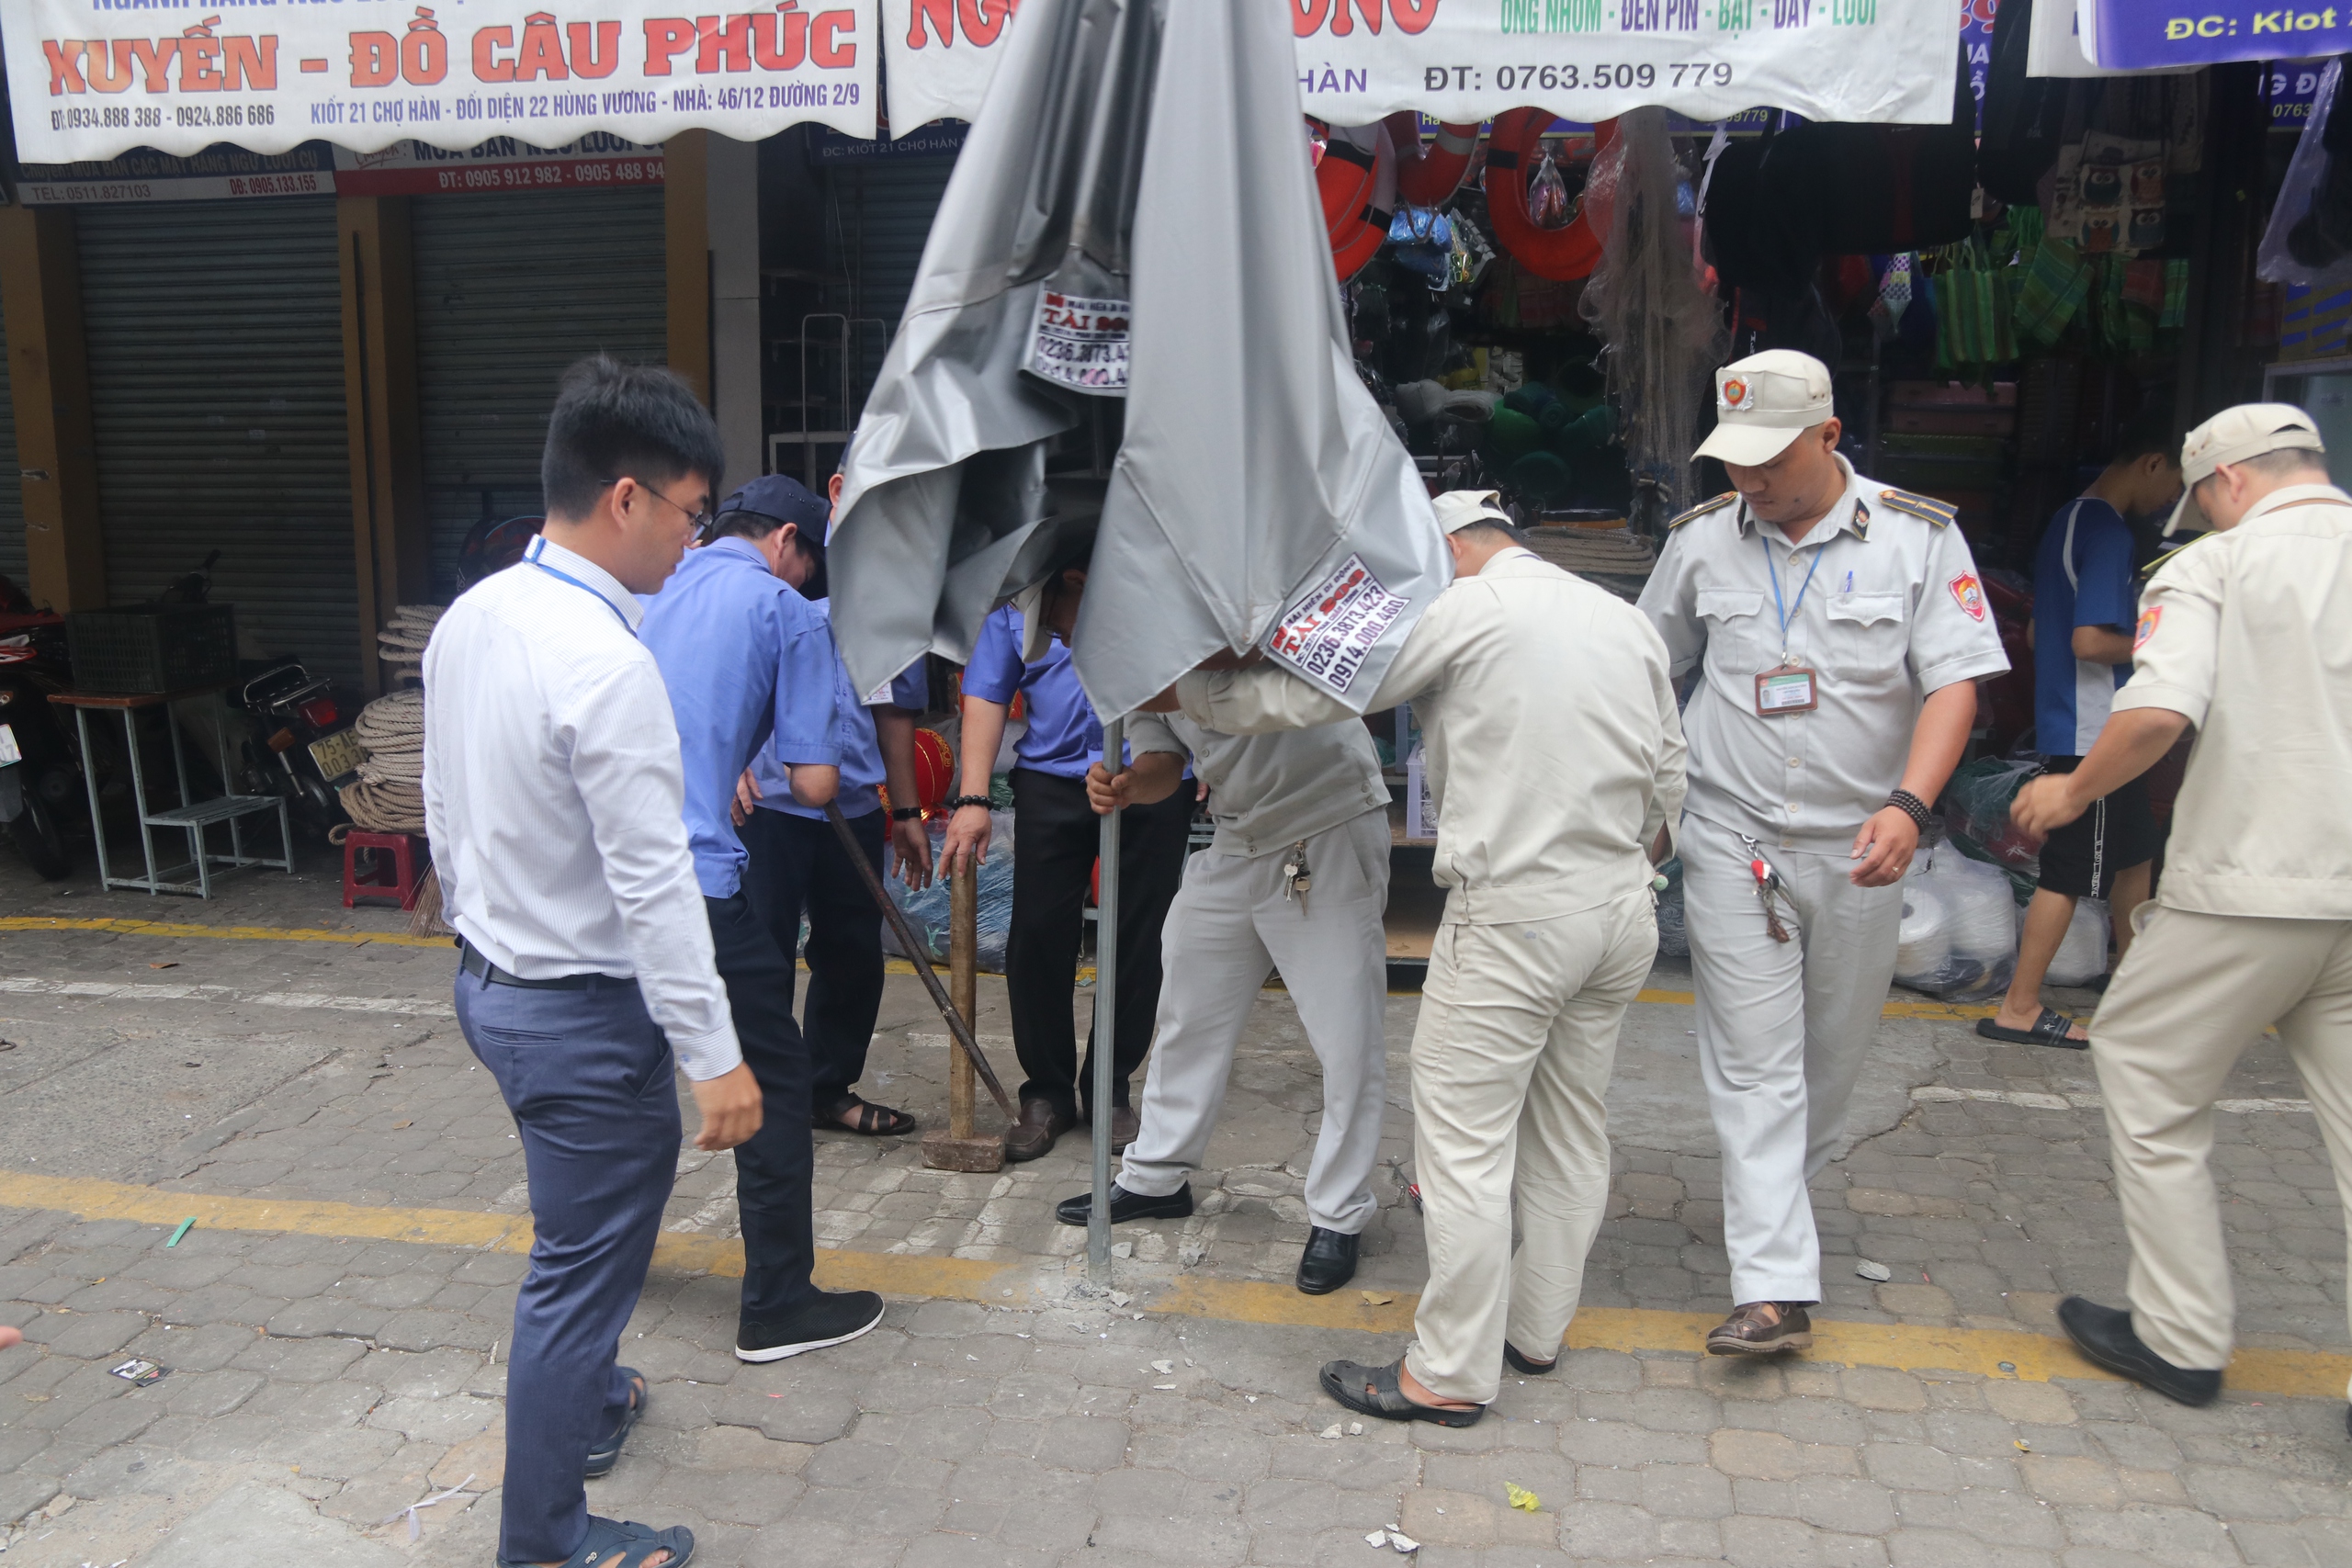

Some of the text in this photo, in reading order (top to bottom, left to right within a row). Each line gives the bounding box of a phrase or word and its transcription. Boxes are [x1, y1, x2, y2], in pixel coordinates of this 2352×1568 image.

[2164, 16, 2238, 40] ĐC:
[2252, 6, 2337, 34] Kiot
[42, 15, 278, 96] XUYẾN
[348, 6, 448, 88] ĐỒ
[471, 11, 622, 83] CÂU
[644, 0, 856, 76] PHÚC
[1424, 62, 1733, 92] ĐT: 0763.509 779
[134, 107, 161, 128] 388
[176, 105, 243, 128] 0924.886
[247, 104, 275, 127] 686
[311, 95, 345, 124] KIỐT
[349, 102, 366, 123] 21
[372, 98, 403, 127] CHỢ
[408, 96, 441, 122] HÀN
[456, 90, 482, 120] ĐỐI
[487, 92, 524, 124] DIỆN
[529, 96, 548, 118] 22
[553, 90, 596, 117] HÙNG
[602, 90, 657, 115] VƯƠNG
[673, 85, 712, 112] NHÀ:
[718, 86, 763, 110] 46/12
[769, 80, 828, 108] ĐƯỜNG
[832, 83, 860, 107] 2/9
[879, 142, 894, 153] 21
[249, 175, 317, 195] 0905.133.155
[465, 170, 501, 186] 0905
[503, 167, 531, 186] 912
[535, 165, 562, 184] 982
[575, 164, 611, 182] 0905
[616, 163, 643, 180] 488
[30, 184, 152, 201] TEL: 0511.827103
[1306, 585, 1385, 675] 0236.3873.423
[1329, 600, 1406, 688] 0914.000.460
